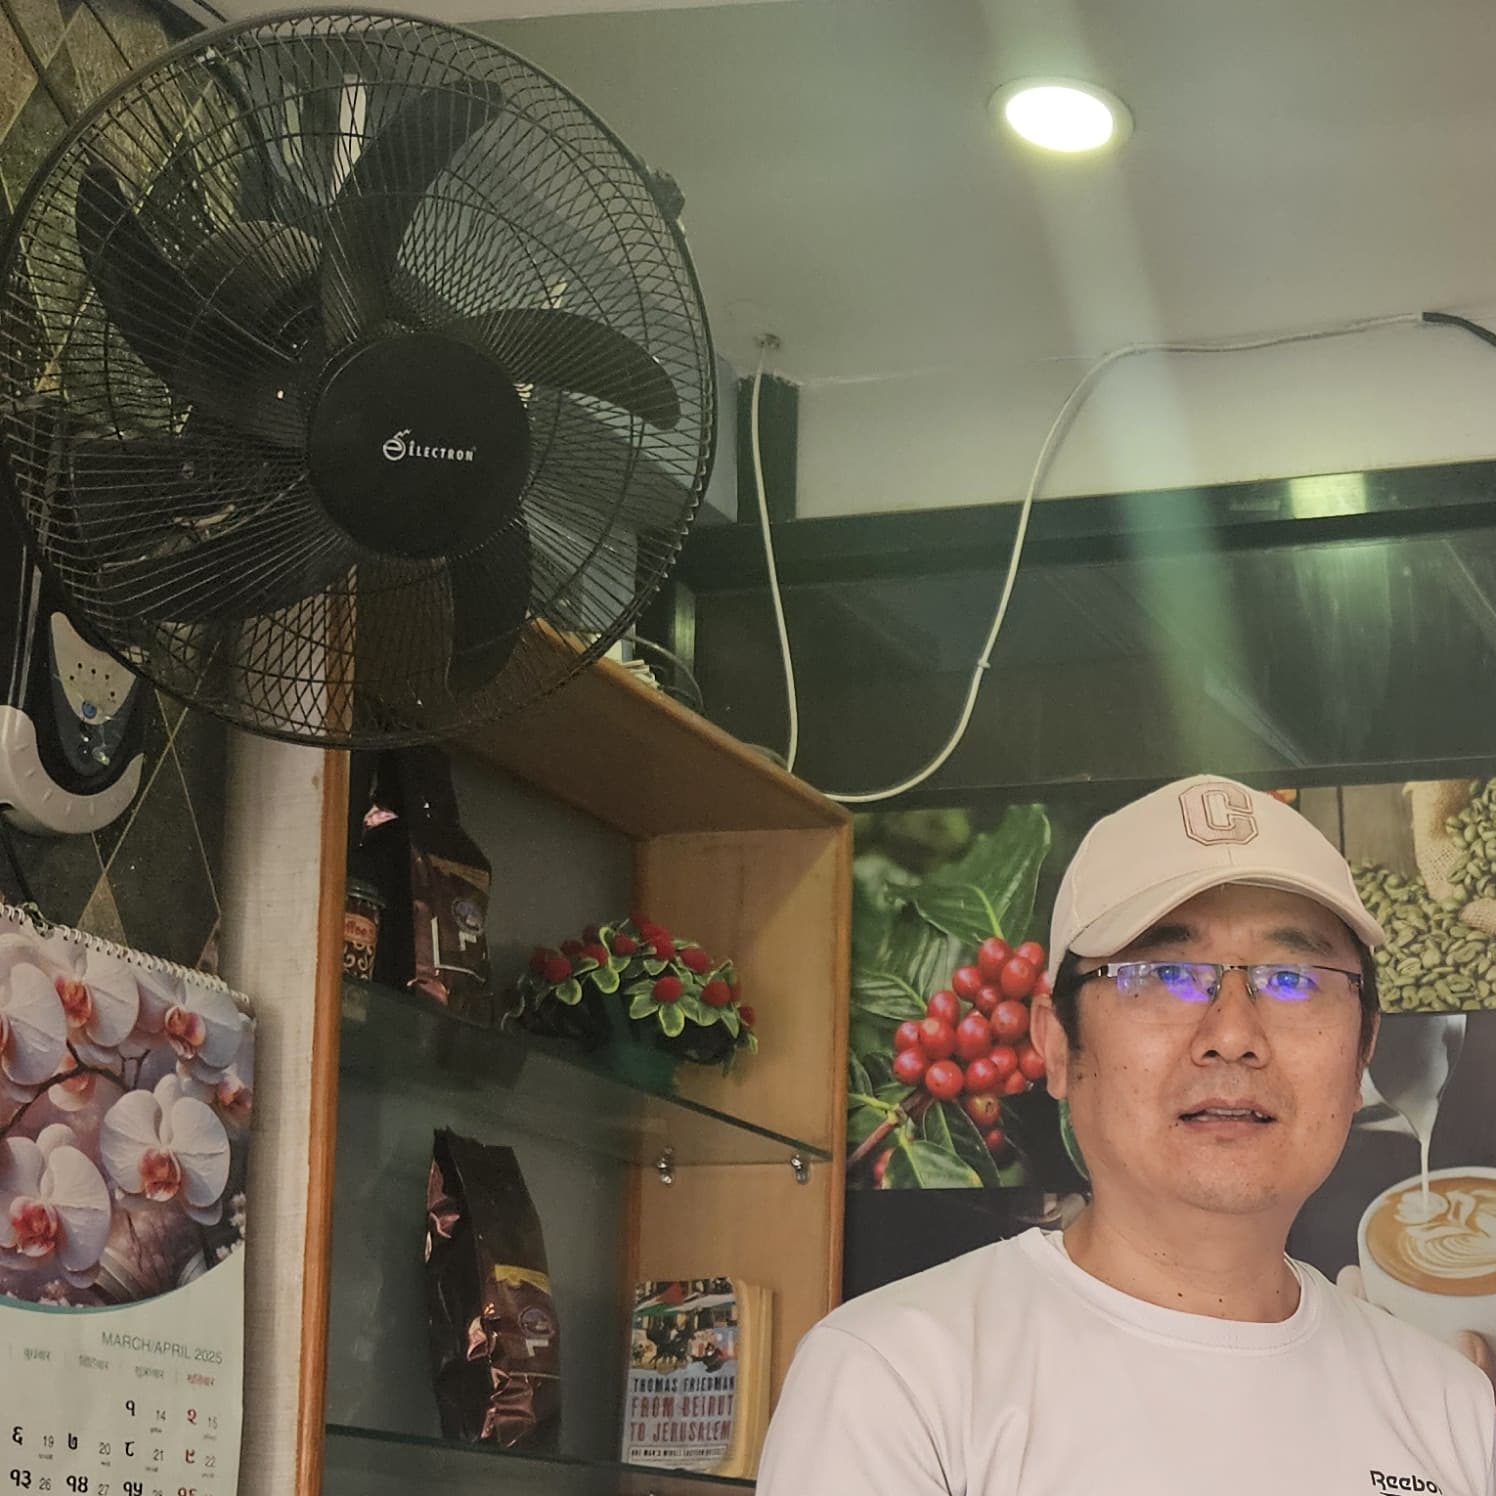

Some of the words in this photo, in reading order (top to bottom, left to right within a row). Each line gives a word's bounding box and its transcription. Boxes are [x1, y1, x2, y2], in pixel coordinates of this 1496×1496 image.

[1178, 781, 1259, 846] C
[101, 1331, 191, 1359] MARCH/APRIL
[194, 1347, 223, 1365] 2025
[633, 1377, 678, 1393] THOMAS
[683, 1375, 735, 1392] FRIEDMAN
[125, 1399, 136, 1417] १
[156, 1409, 167, 1421] 14
[186, 1408, 198, 1425] २
[207, 1416, 218, 1430] 15
[632, 1395, 675, 1418] FROM
[630, 1422, 646, 1442] TO
[653, 1420, 732, 1442] JERUSALEM
[12, 1425, 24, 1446] ६
[43, 1435, 55, 1448] 19
[67, 1432, 79, 1450] ७
[98, 1441, 112, 1456] 20
[125, 1440, 136, 1457] ८
[153, 1448, 164, 1461] 21
[185, 1448, 196, 1464] ९
[204, 1455, 217, 1468] 22
[10, 1468, 32, 1490] १३
[66, 1475, 89, 1493] १४
[97, 1483, 110, 1496] 27
